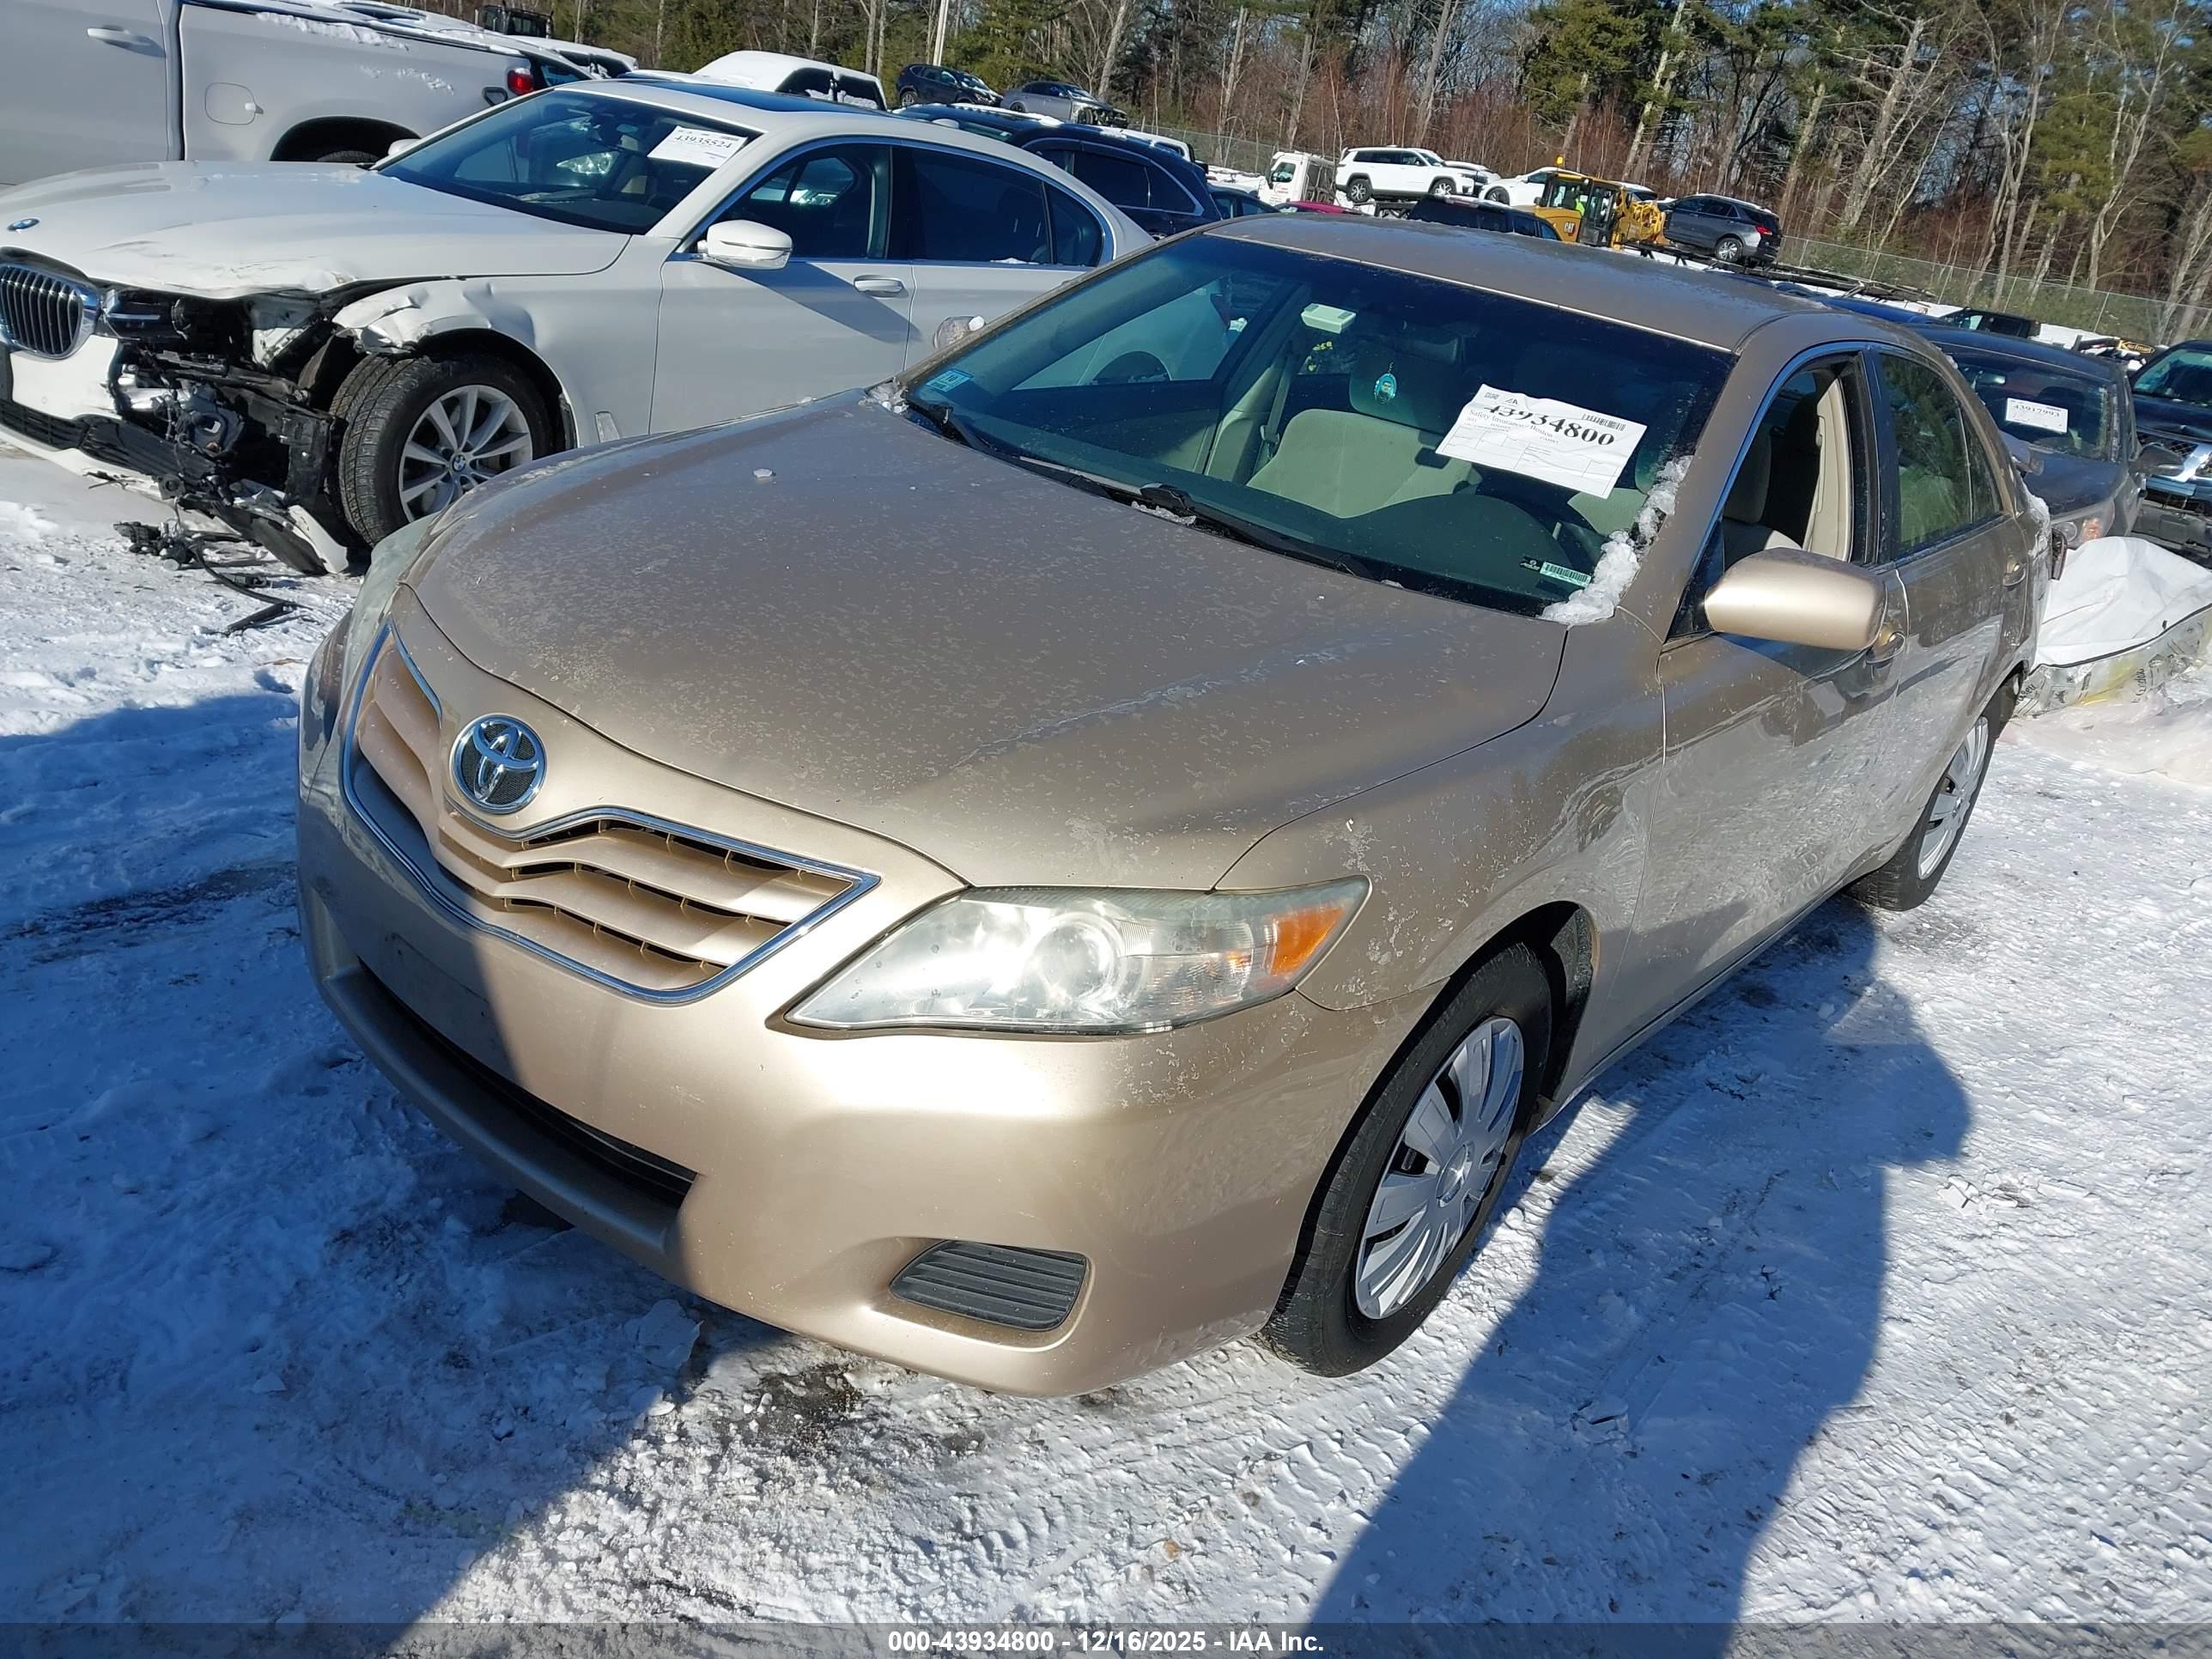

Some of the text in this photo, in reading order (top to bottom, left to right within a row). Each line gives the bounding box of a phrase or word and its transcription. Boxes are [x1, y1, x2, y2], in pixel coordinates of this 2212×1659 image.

[1564, 222, 1575, 234] CAT
[1469, 409, 1489, 421] Safety
[1530, 425, 1553, 439] Boston
[1483, 404, 1615, 446] 43934800
